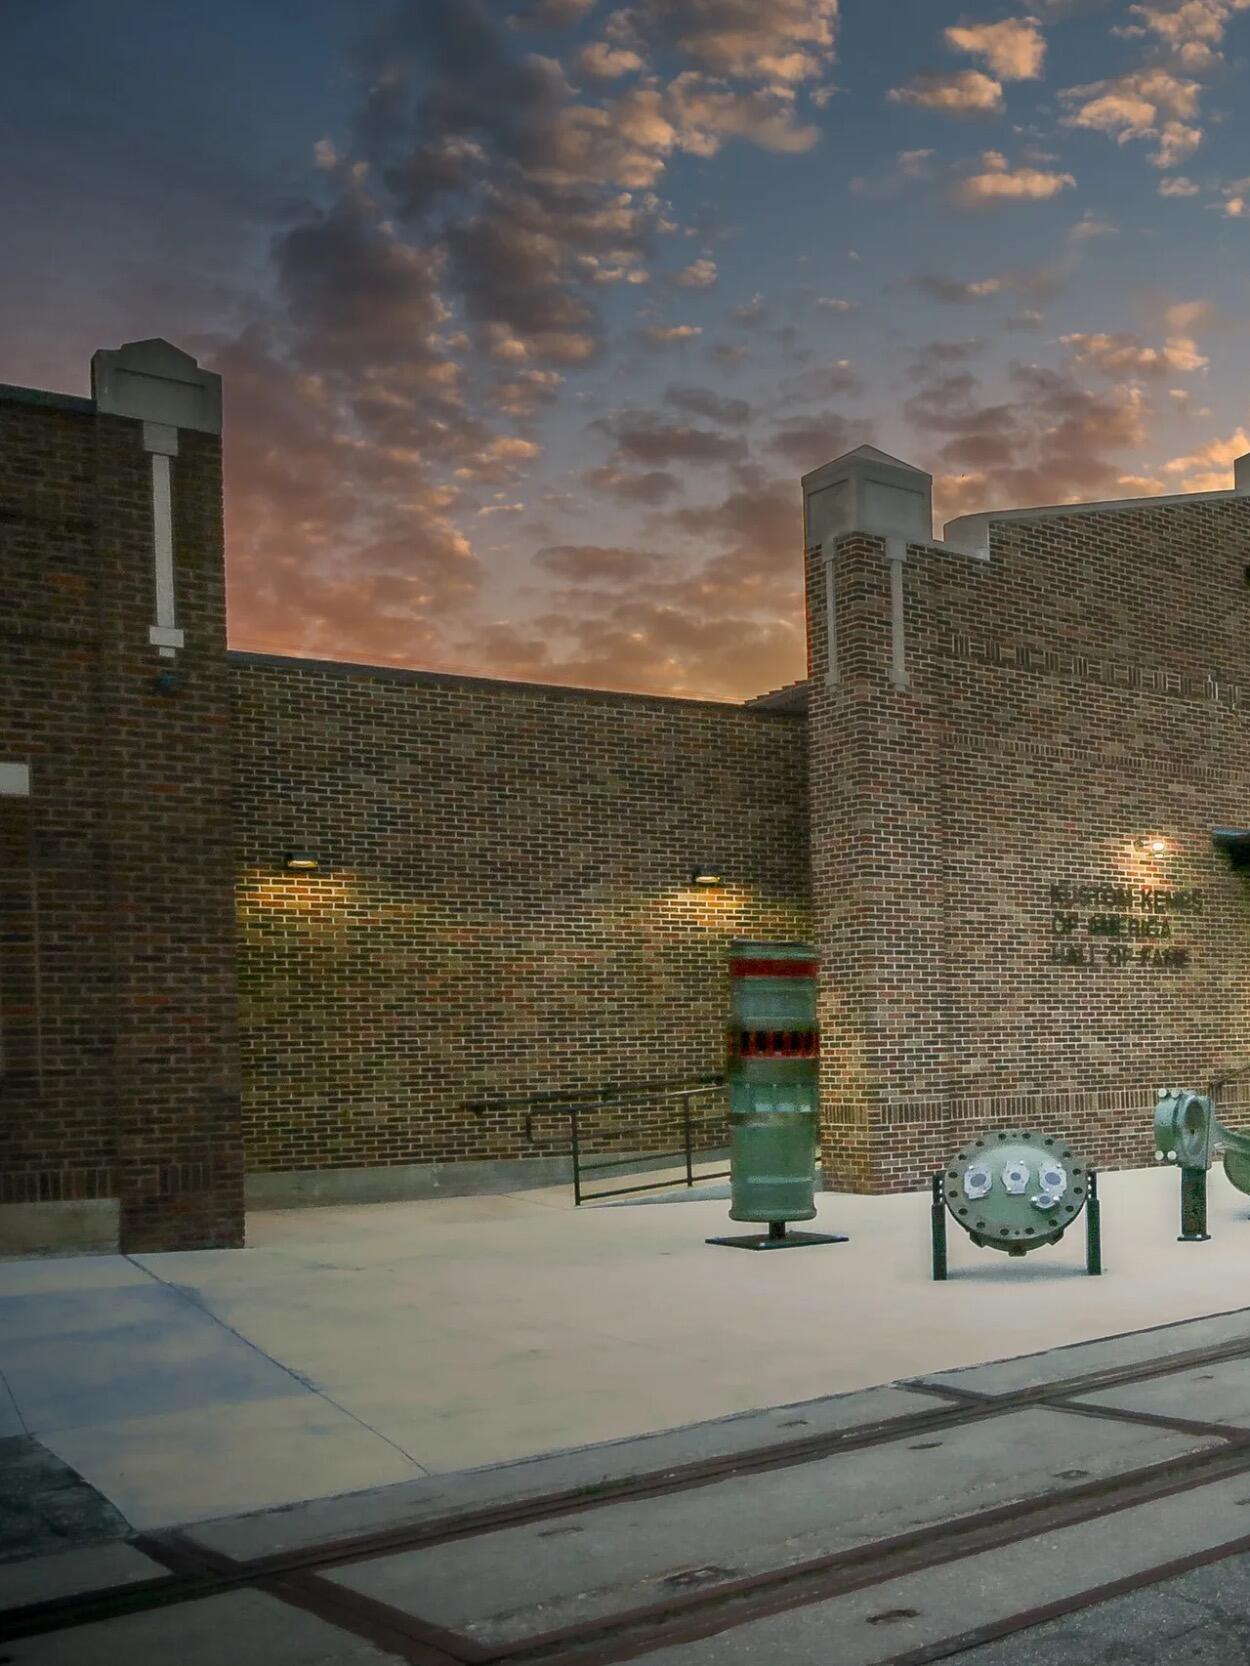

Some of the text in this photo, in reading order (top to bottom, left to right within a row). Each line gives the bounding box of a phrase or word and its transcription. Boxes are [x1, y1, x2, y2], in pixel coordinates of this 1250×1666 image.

[1051, 911, 1171, 938] OF AMERICA
[1051, 944, 1191, 968] HALL OF FAME
